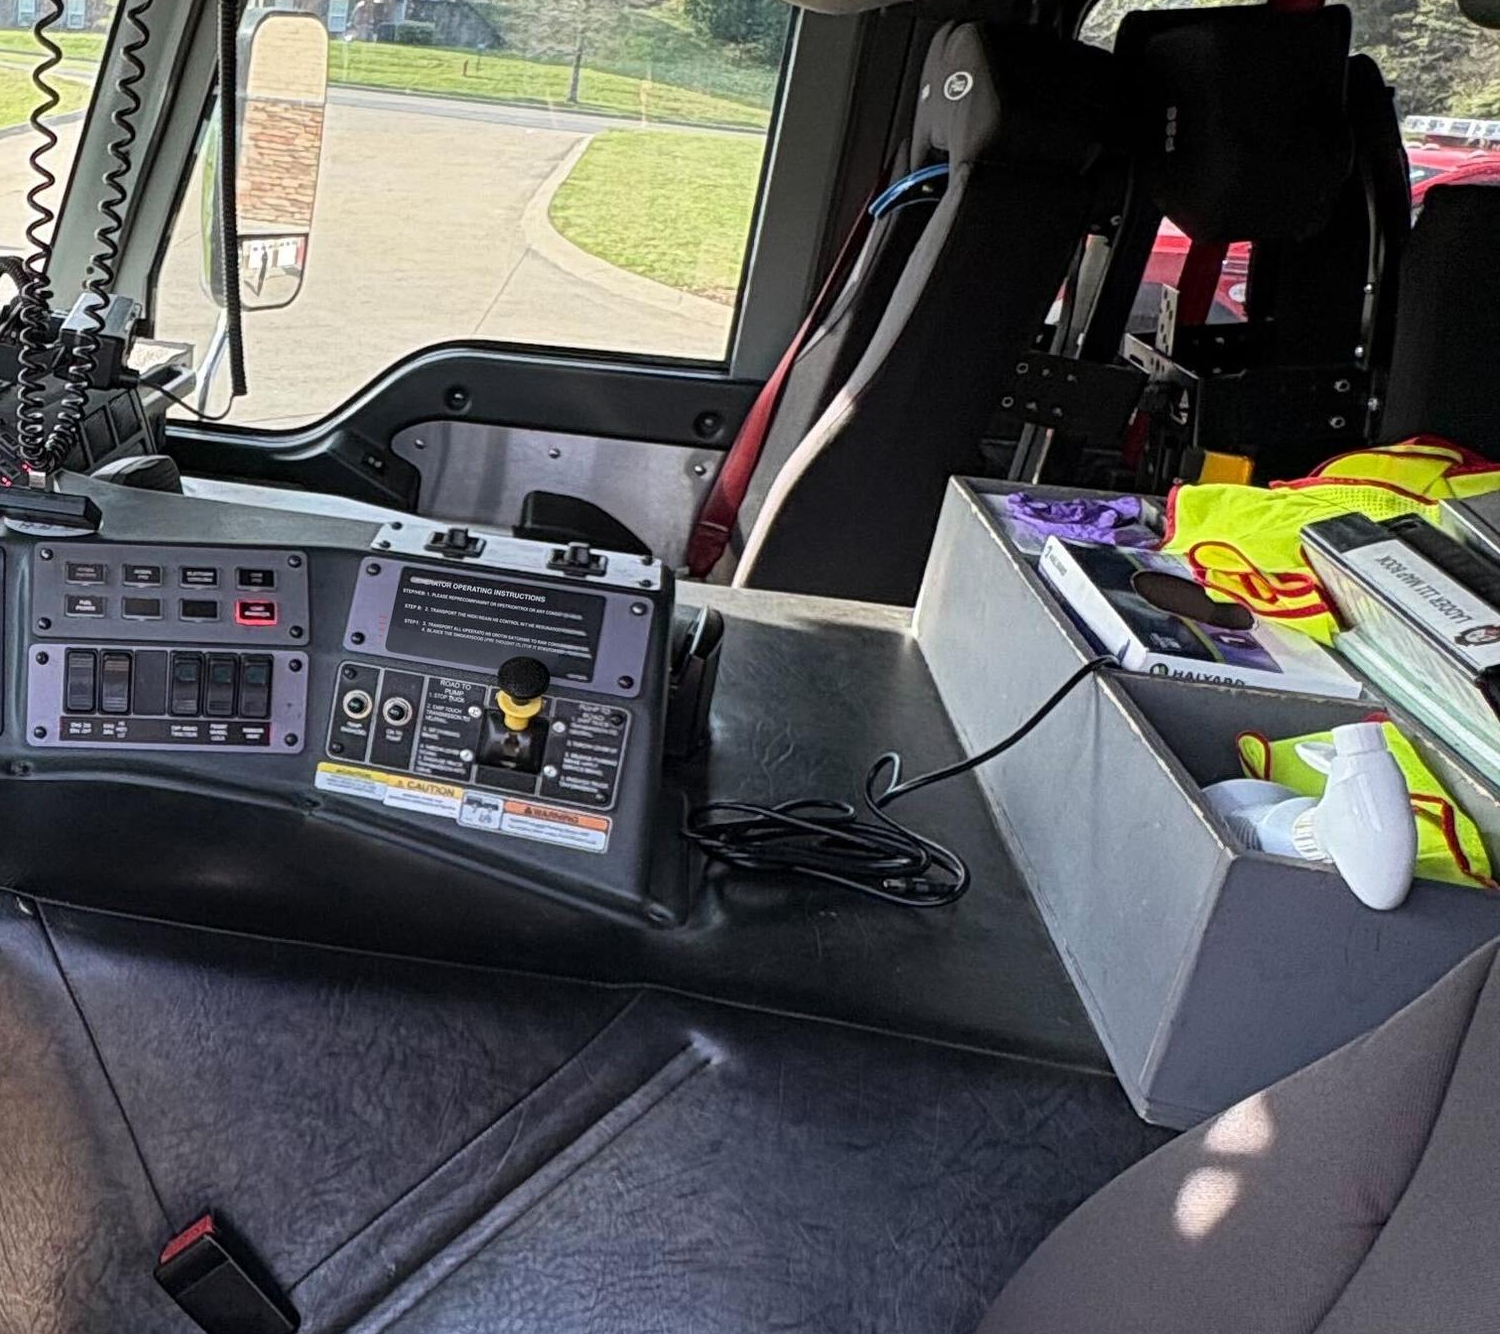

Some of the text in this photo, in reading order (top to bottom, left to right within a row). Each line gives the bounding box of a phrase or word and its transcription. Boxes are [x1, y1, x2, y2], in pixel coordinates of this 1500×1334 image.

[410, 576, 452, 589] ERATOR
[452, 582, 493, 595] OPERATING
[493, 589, 547, 603] INSTRUCTIONS
[1427, 594, 1472, 626] LADDER
[440, 679, 472, 691] ROAD TO
[444, 688, 465, 696] PUMP
[407, 778, 456, 797] CAUTION
